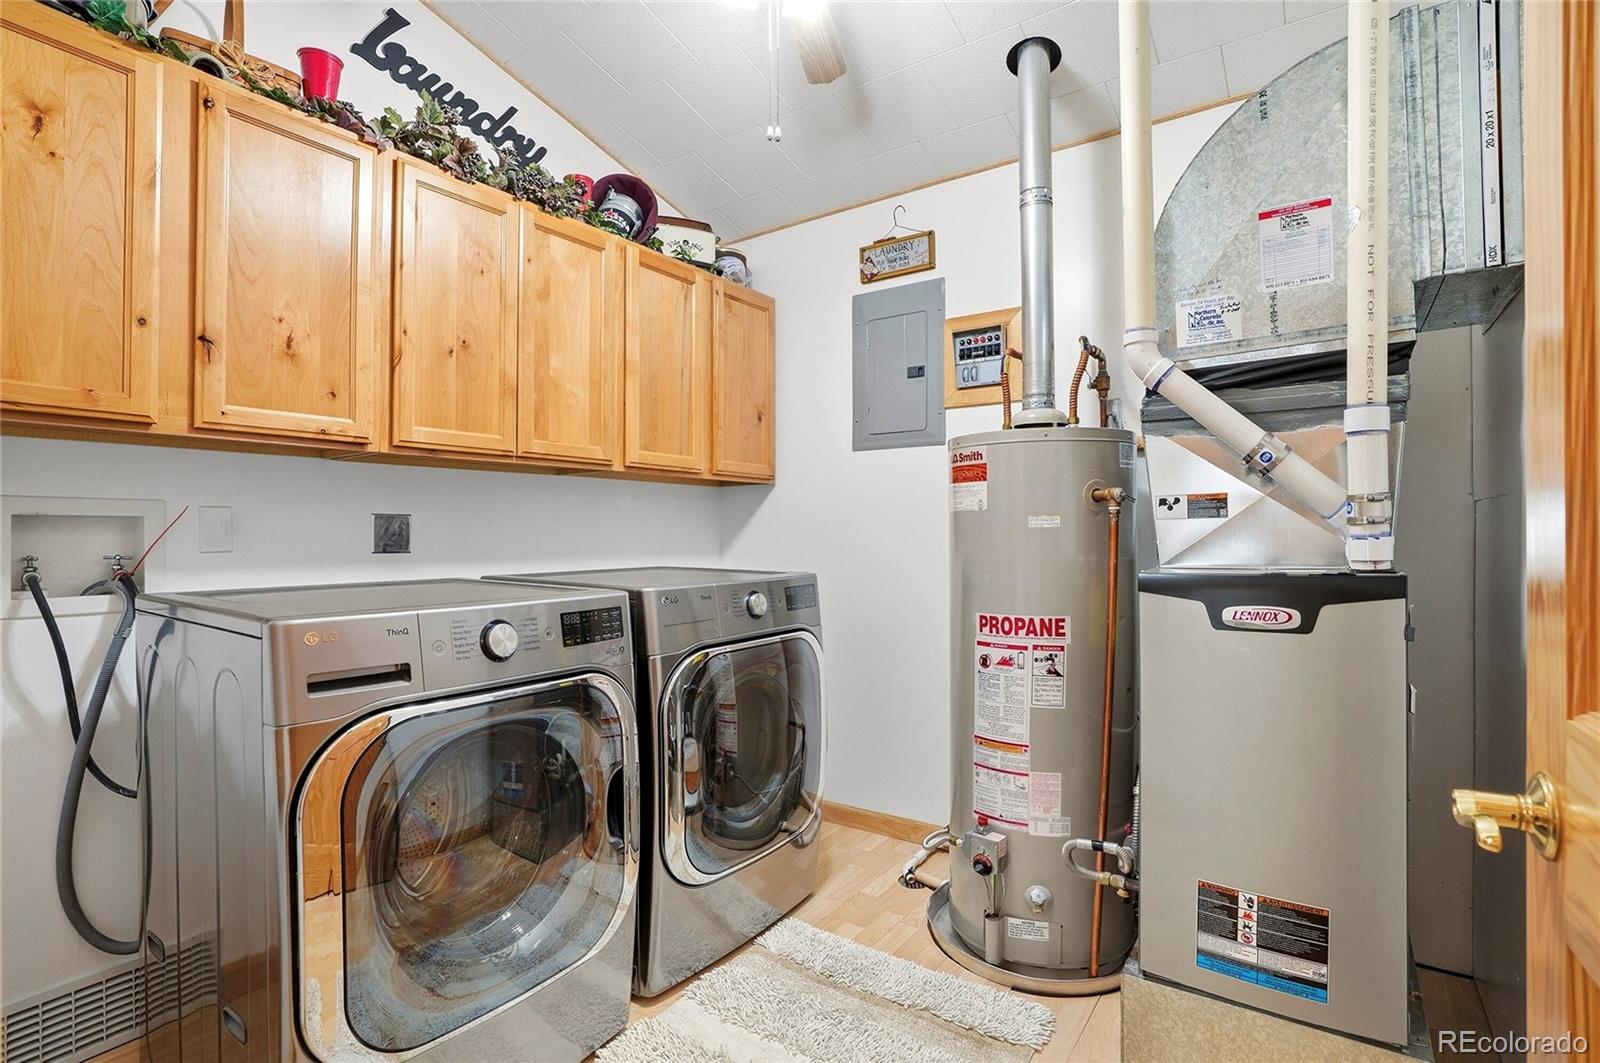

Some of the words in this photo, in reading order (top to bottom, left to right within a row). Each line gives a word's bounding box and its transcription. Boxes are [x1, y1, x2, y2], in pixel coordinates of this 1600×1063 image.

[350, 7, 548, 169] Laundry
[875, 240, 914, 257] LAUNDRY
[1488, 245, 1497, 263] HDX
[1366, 333, 1374, 404] PRESSU
[959, 450, 983, 463] Smith
[1232, 610, 1280, 622] LENNOX
[386, 627, 409, 637] ThinQ
[979, 615, 1066, 637] PROPANE
[1206, 883, 1237, 895] WARNING
